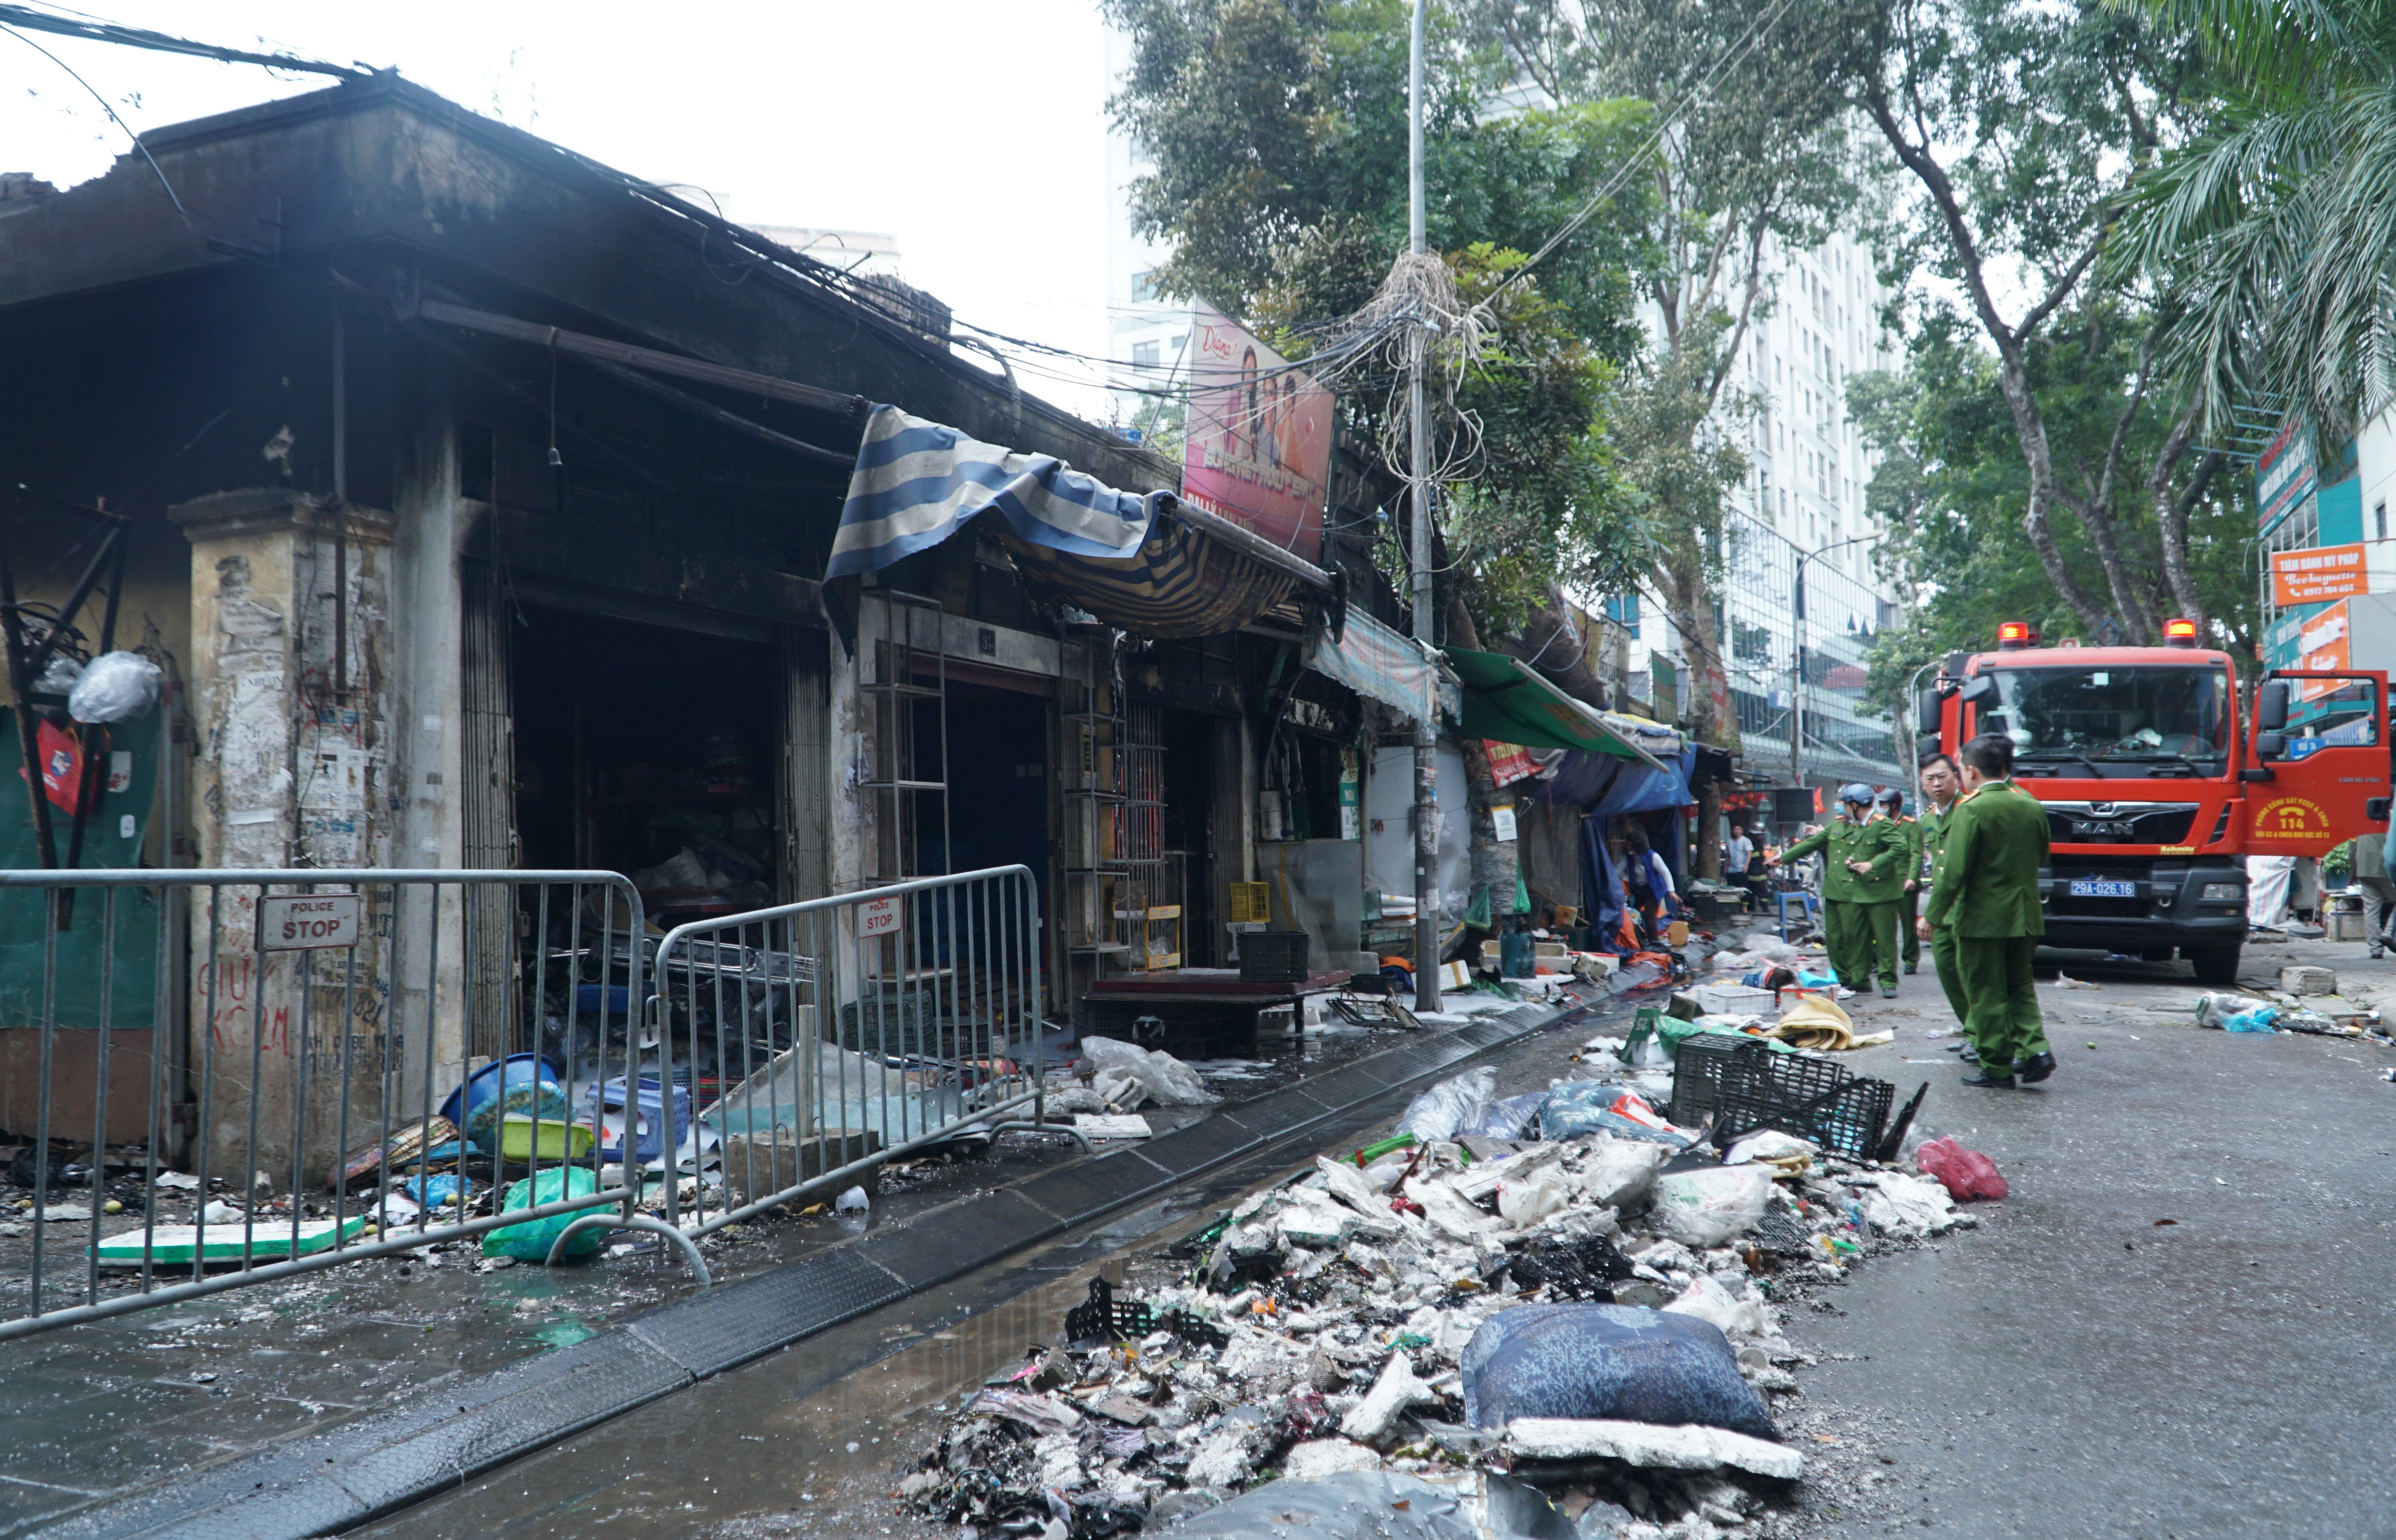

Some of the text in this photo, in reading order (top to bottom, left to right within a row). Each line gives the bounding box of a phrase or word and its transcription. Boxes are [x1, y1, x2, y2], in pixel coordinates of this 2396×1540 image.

[1203, 325, 1237, 359] Diana
[2073, 823, 2134, 835] MAN
[2280, 818, 2305, 829] 114
[2073, 883, 2133, 895] 29A-026.16
[291, 902, 334, 912] POLICE
[869, 902, 889, 912] POLICE
[867, 914, 893, 930] STOP
[283, 920, 340, 939] STOP
